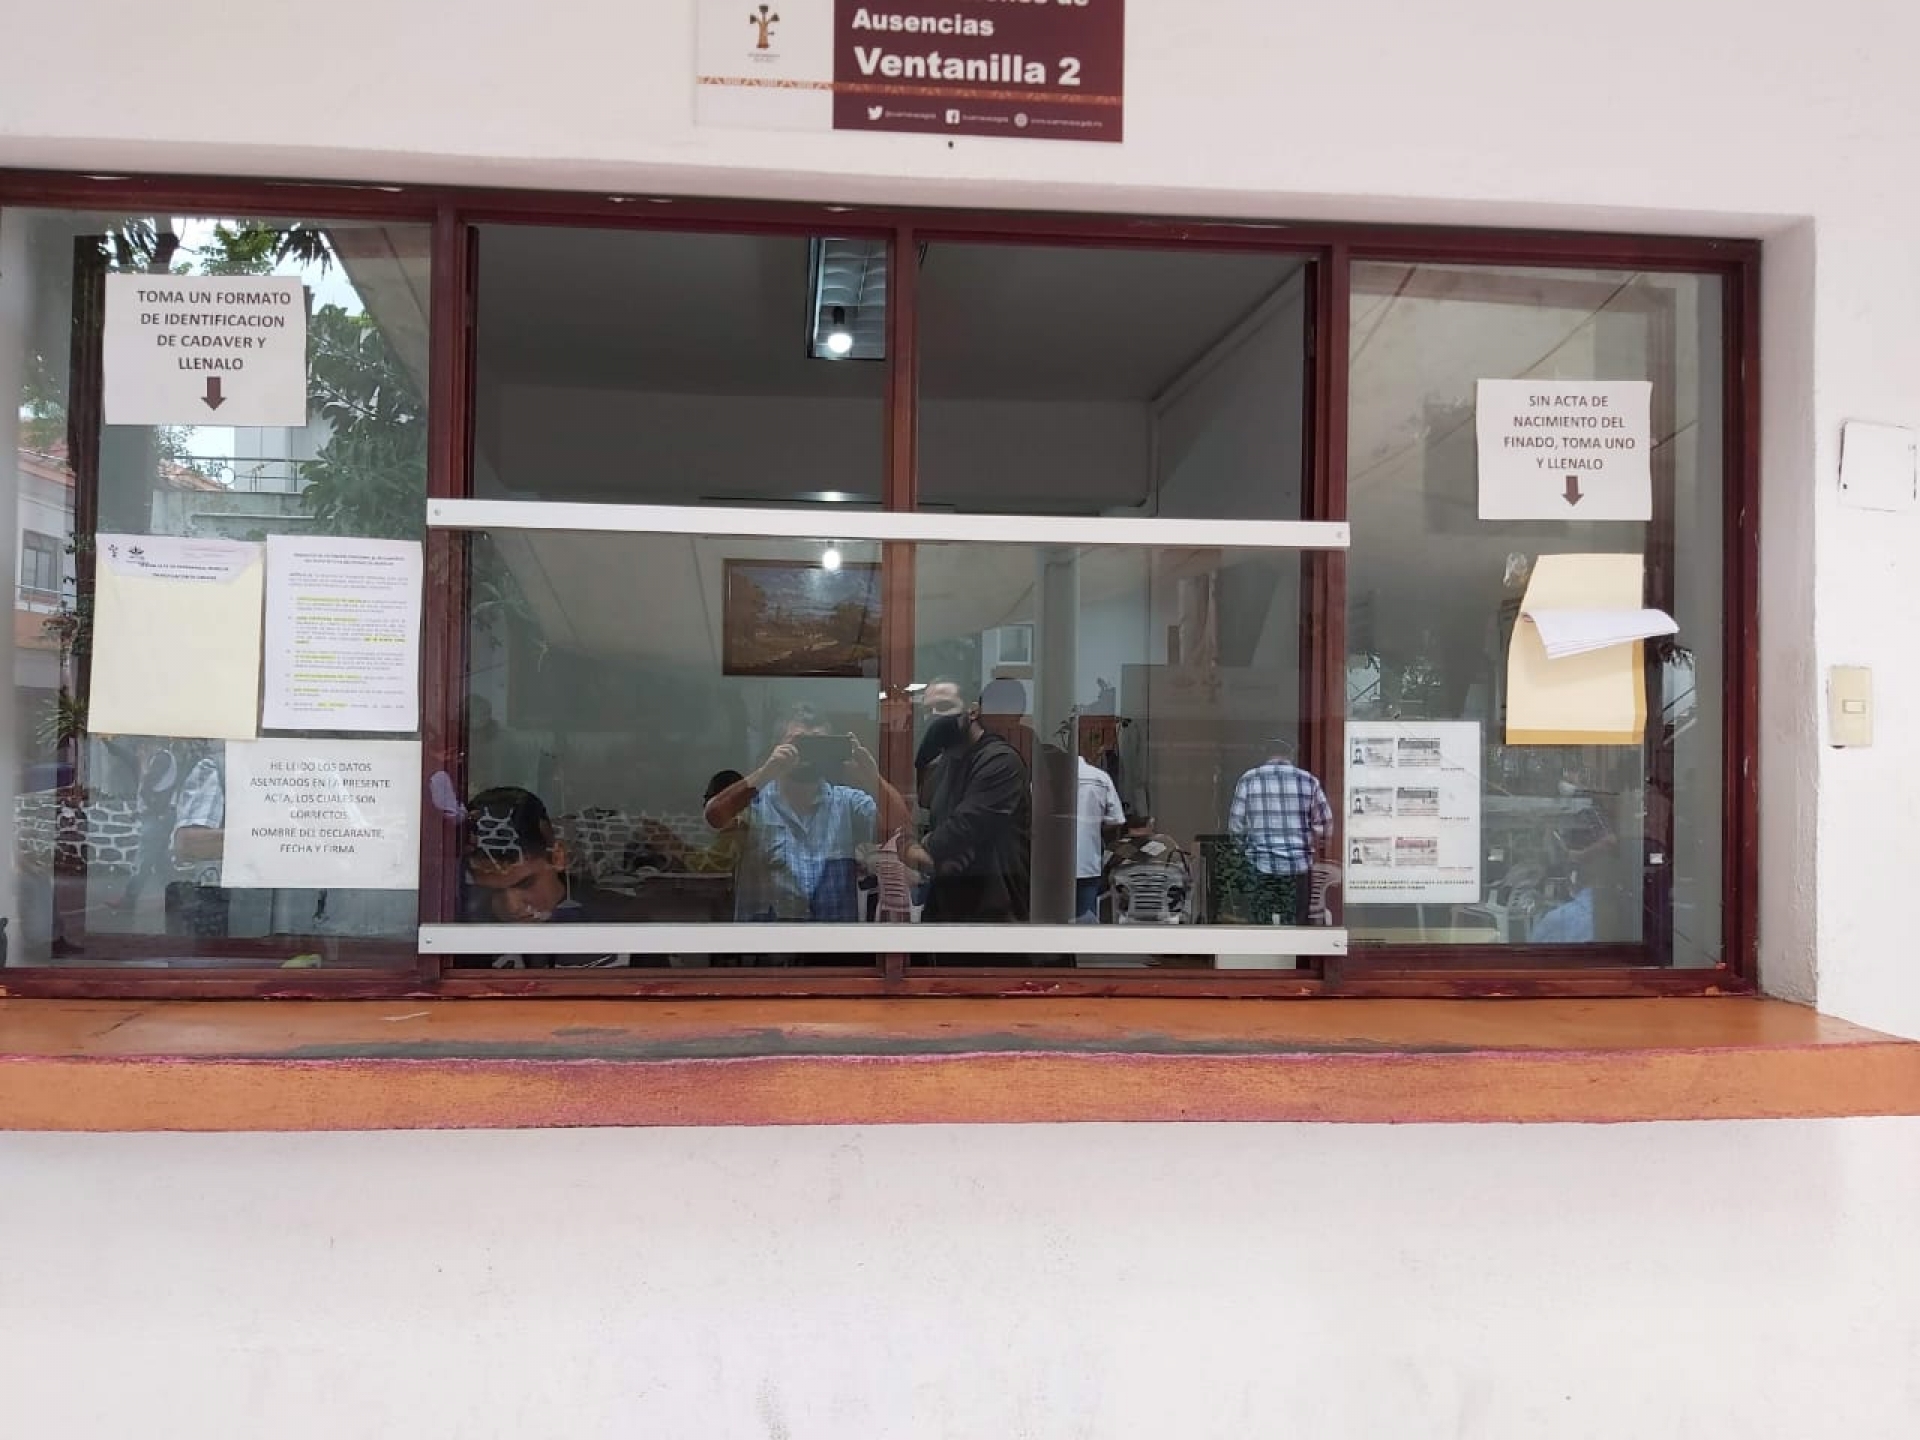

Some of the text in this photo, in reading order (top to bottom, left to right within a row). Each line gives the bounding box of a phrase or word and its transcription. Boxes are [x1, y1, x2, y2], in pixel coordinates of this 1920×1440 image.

[852, 8, 995, 37] Ausencias
[854, 46, 1082, 86] Ventanilla 2
[137, 290, 292, 305] TOMA UN FORMATO
[140, 312, 285, 328] DE IDENTIFICACION
[156, 334, 267, 349] DE CADAVER Y
[178, 357, 244, 370] LLENALO
[1529, 395, 1609, 408] SIN ACTA DE
[1513, 416, 1626, 429] NACIMIENTO DEL
[1503, 436, 1636, 450] FINADO, TOMA UNO
[1536, 458, 1604, 470] Y LLENALO
[338, 762, 373, 772] DATOS
[250, 777, 310, 788] ASENTADOS
[312, 778, 326, 788] EN
[342, 779, 392, 789] PRESENTE
[296, 794, 315, 804] LOS
[355, 795, 377, 805] SON
[251, 827, 297, 838] NOMBRE
[280, 843, 313, 854] FECHA
[314, 843, 322, 853] Y
